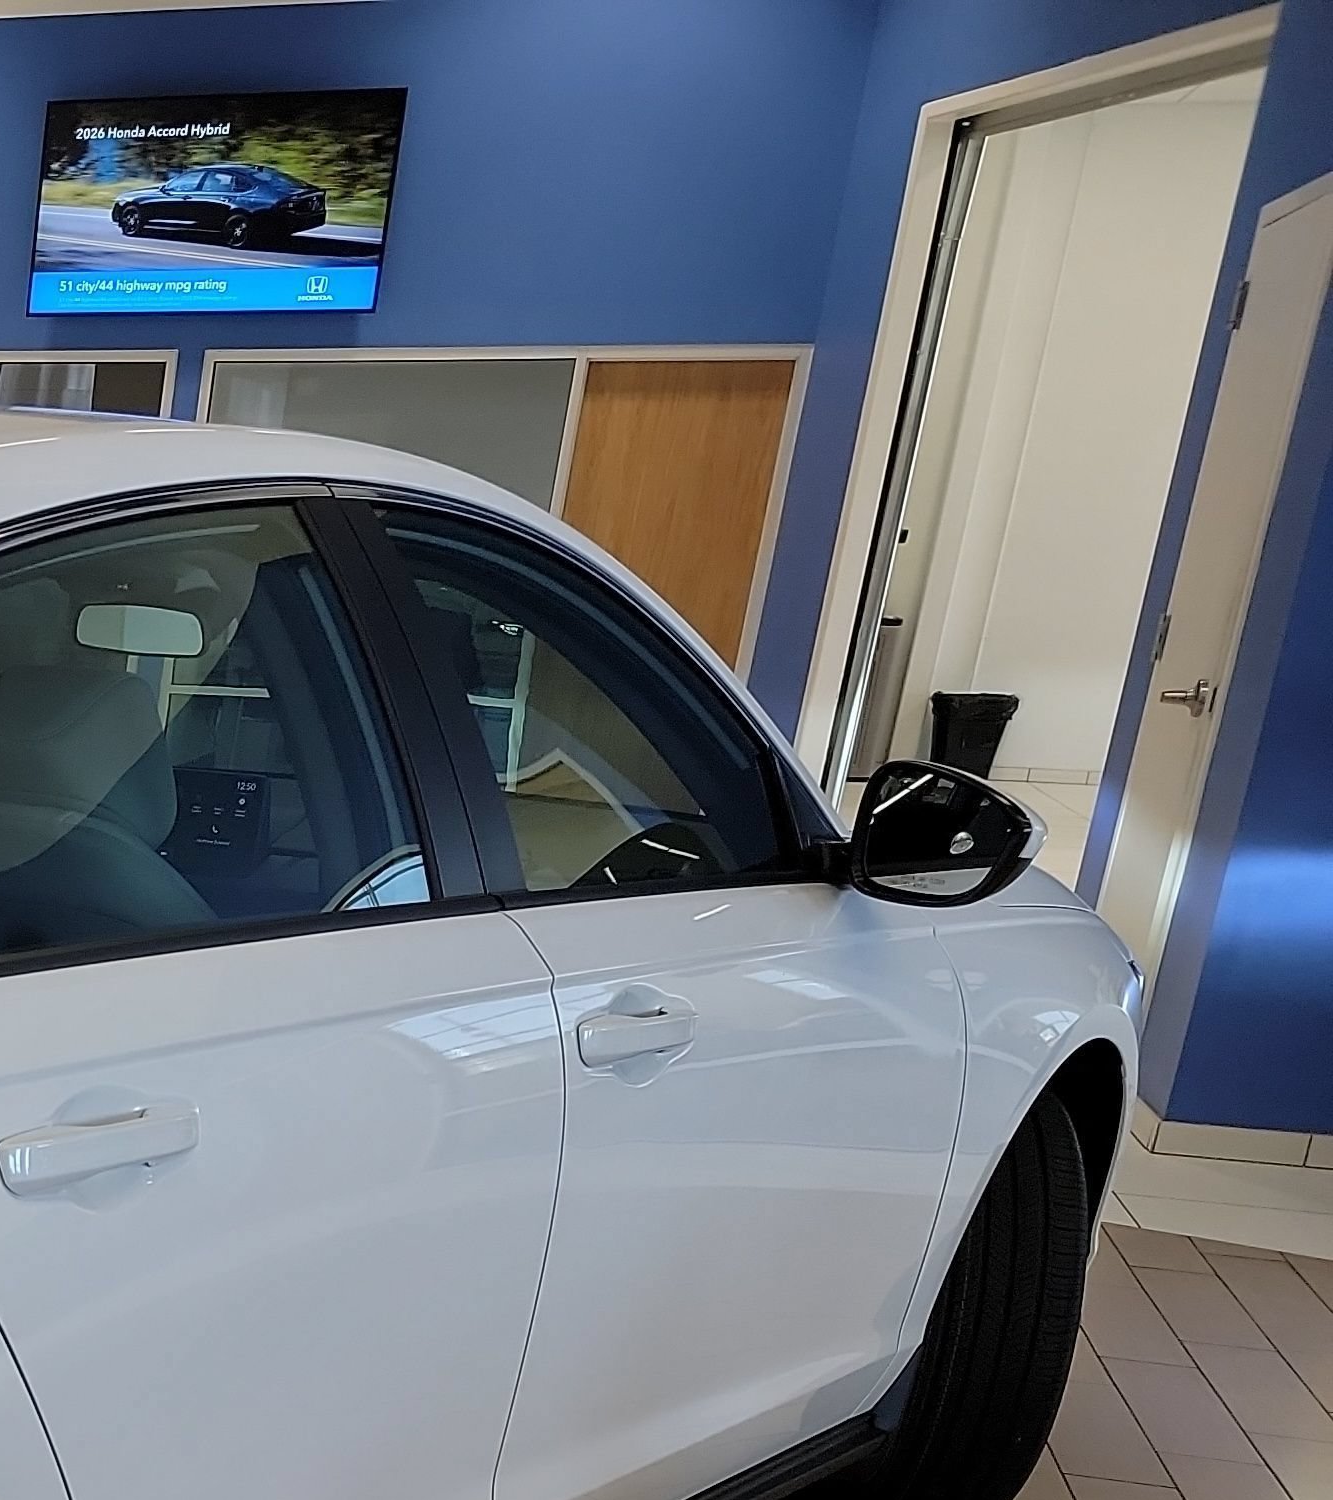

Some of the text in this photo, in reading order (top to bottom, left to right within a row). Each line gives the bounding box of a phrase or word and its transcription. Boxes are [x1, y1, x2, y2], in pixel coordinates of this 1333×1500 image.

[75, 122, 231, 140] 2026 Honda Accord Hybrid
[59, 279, 227, 294] 51 city/44 highway mpg rating
